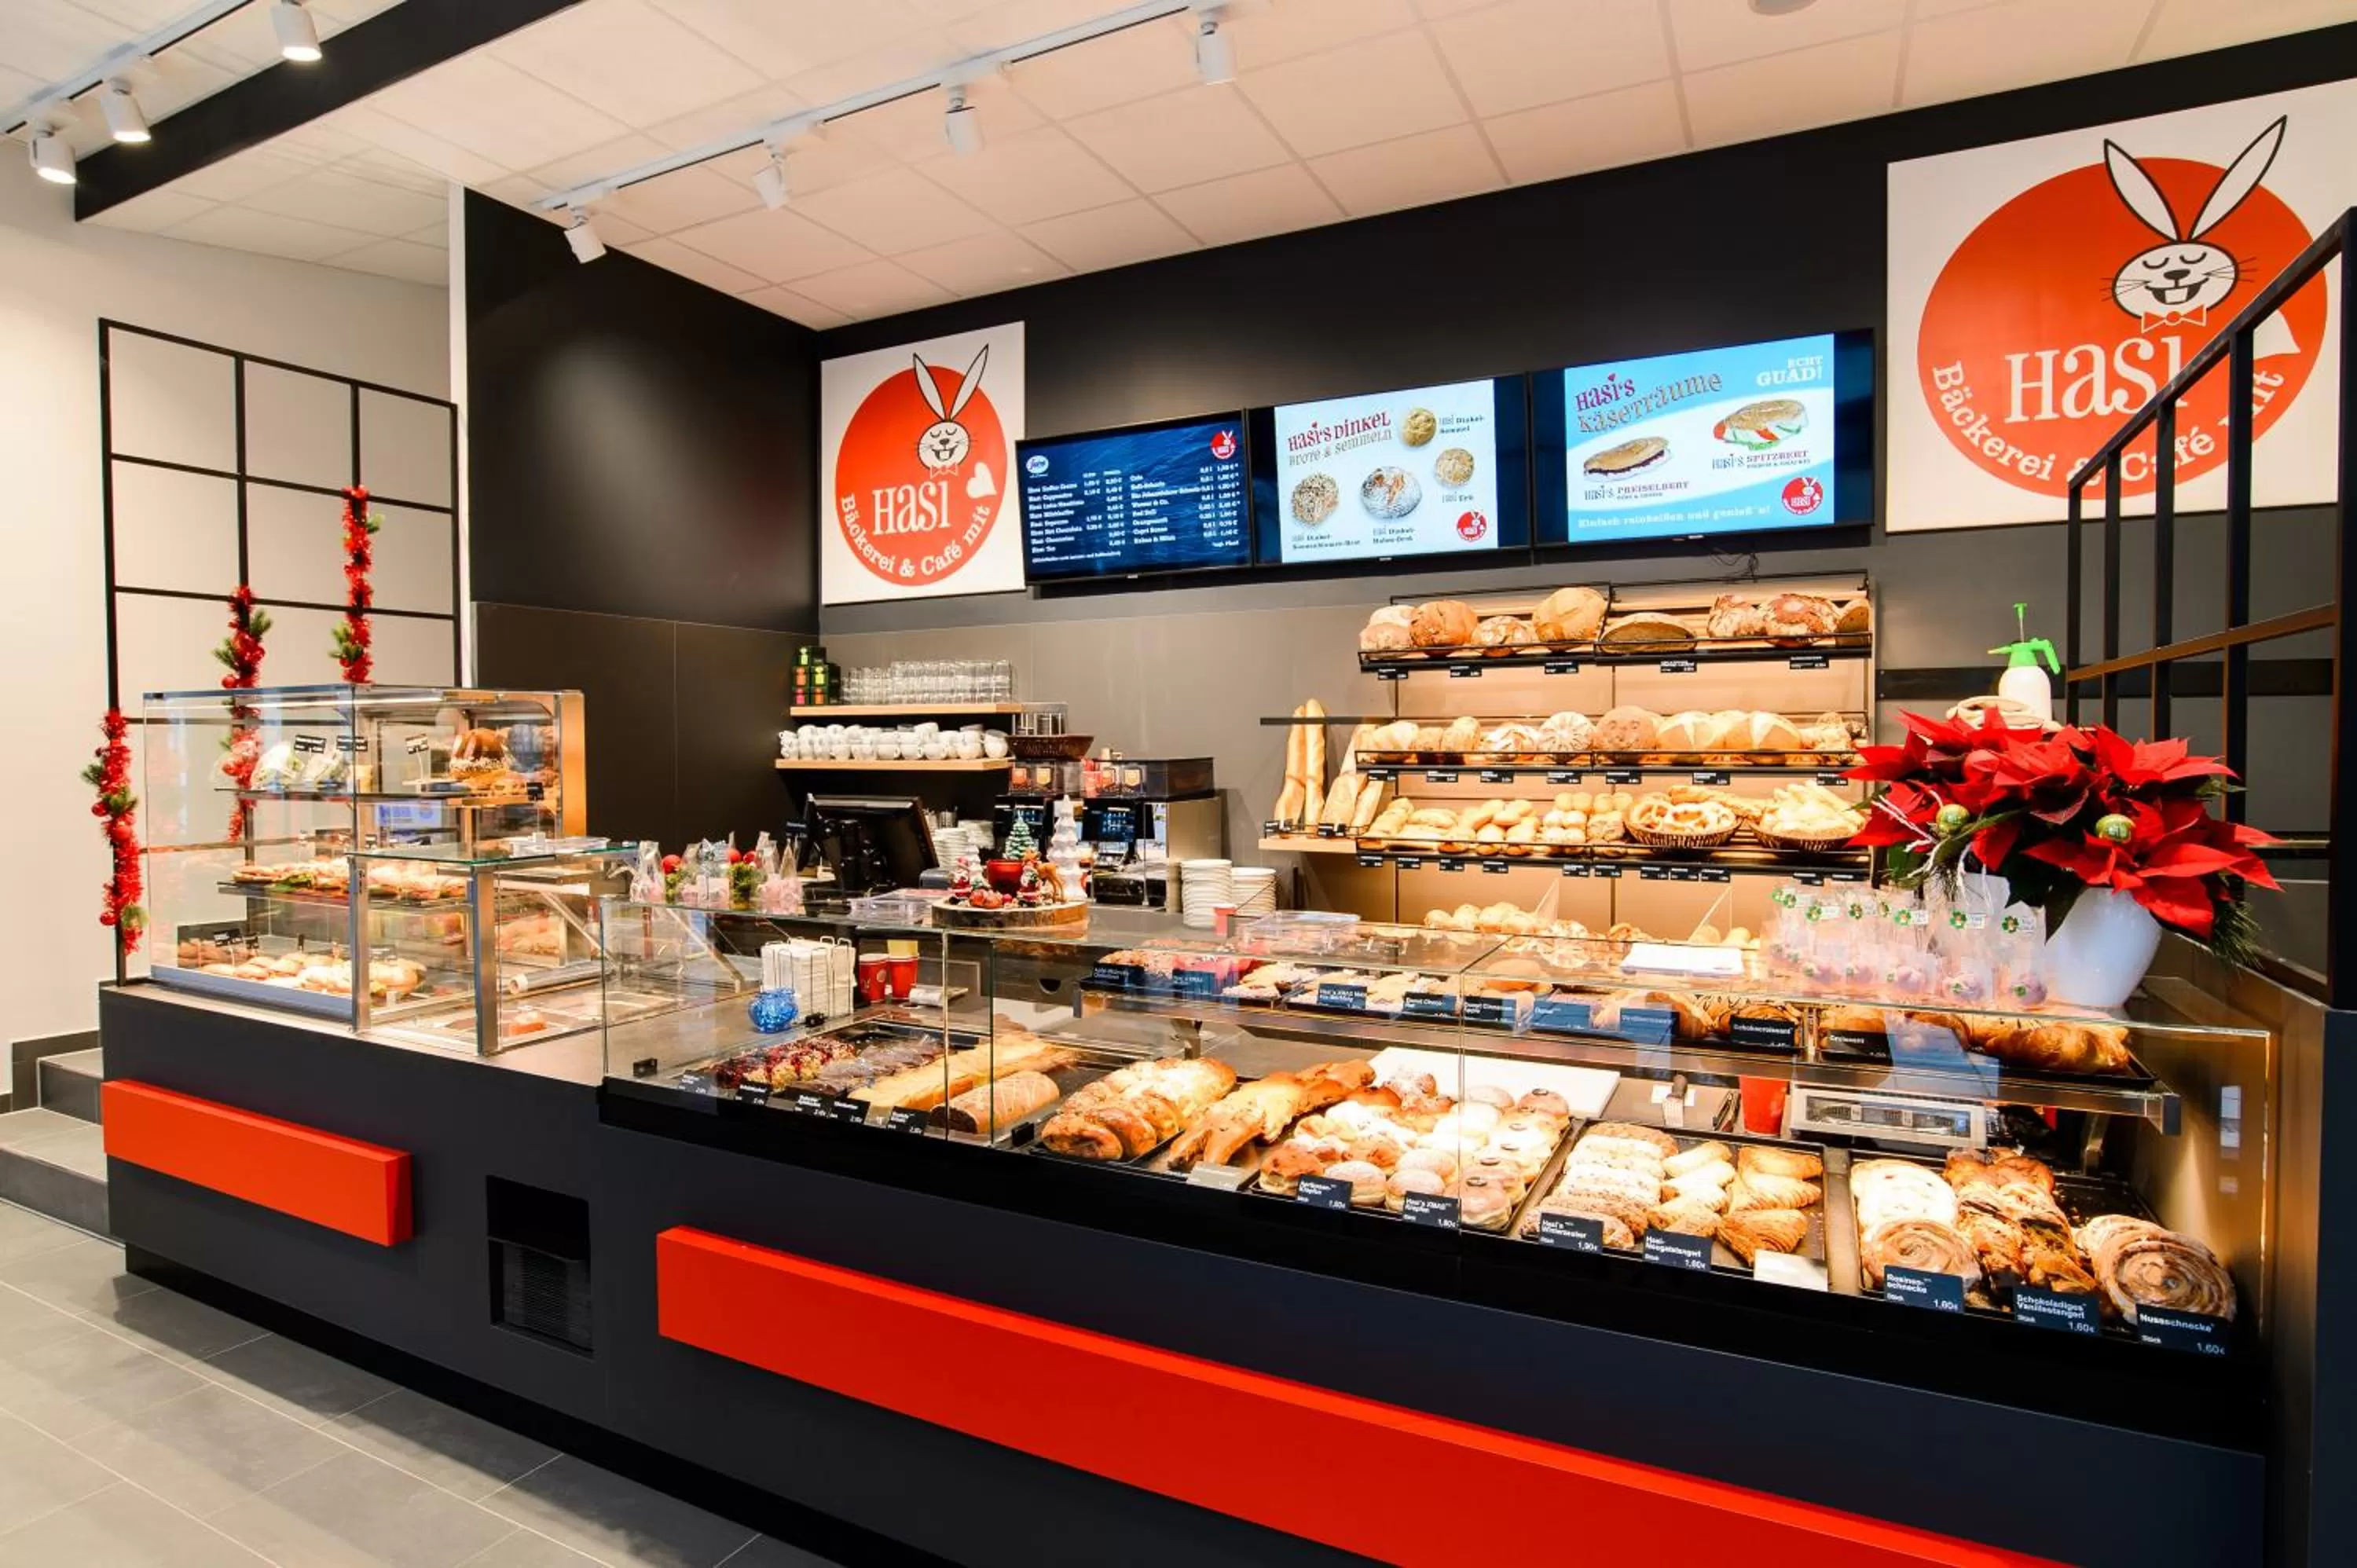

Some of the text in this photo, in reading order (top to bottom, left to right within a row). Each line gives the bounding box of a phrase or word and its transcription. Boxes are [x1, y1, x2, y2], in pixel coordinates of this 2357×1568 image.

[1756, 366, 1824, 387] GUAD!
[1932, 361, 2056, 481] Bäckerei
[2120, 429, 2215, 483] Cfé
[2218, 368, 2285, 430] it
[841, 493, 895, 574] Bäckerei
[900, 558, 915, 577] &
[921, 540, 962, 575] Café
[963, 505, 991, 545] mit
[2017, 1294, 2084, 1311] Schokoladiges
[2139, 1313, 2212, 1332] Nussschnecke
